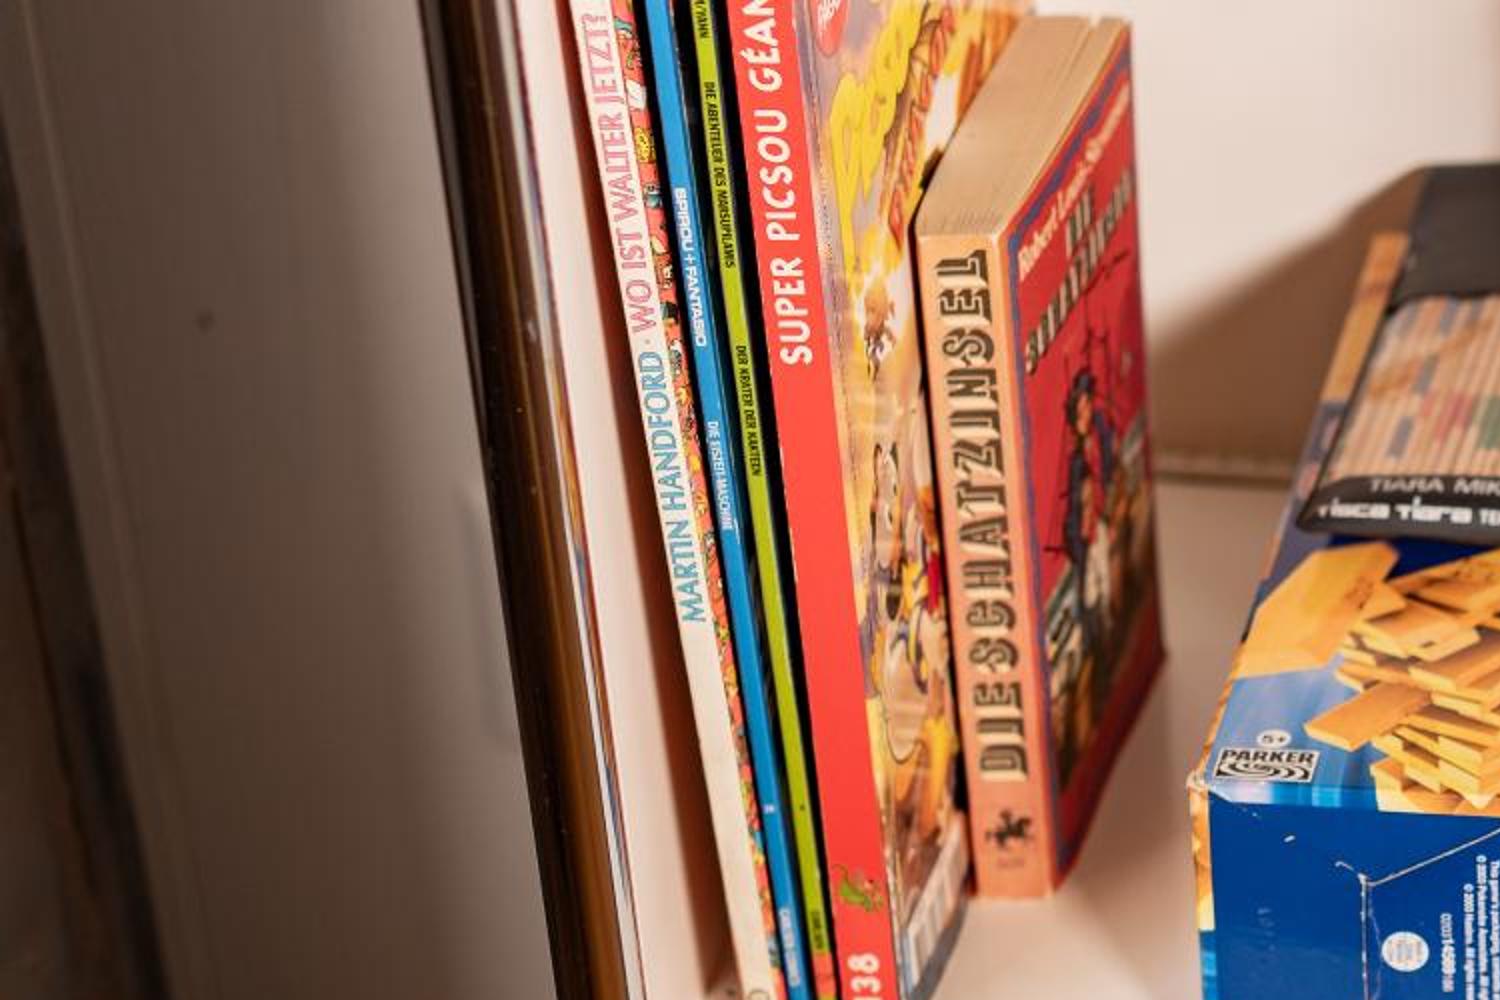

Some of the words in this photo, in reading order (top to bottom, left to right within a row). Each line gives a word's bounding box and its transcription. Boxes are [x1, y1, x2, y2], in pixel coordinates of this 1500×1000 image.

[580, 12, 626, 105] JETZT?
[703, 81, 717, 99] DIE
[706, 100, 726, 164] ABENTEUER
[597, 112, 640, 223] WALTER
[713, 166, 727, 188] DES
[752, 109, 802, 241] PICSOU
[616, 226, 648, 270] IST
[673, 187, 695, 252] SPIROU
[685, 265, 708, 347] FANTASIO
[625, 279, 658, 334] WO
[771, 256, 814, 365] SUPER
[735, 345, 749, 365] DER
[739, 367, 755, 408] KRATER
[638, 351, 688, 511] HANDFORD
[744, 408, 757, 430] DER
[1369, 478, 1445, 494] TIARA
[667, 521, 707, 623] MARTIN
[971, 682, 1028, 785] DIE
[1220, 748, 1316, 764] PARKER
